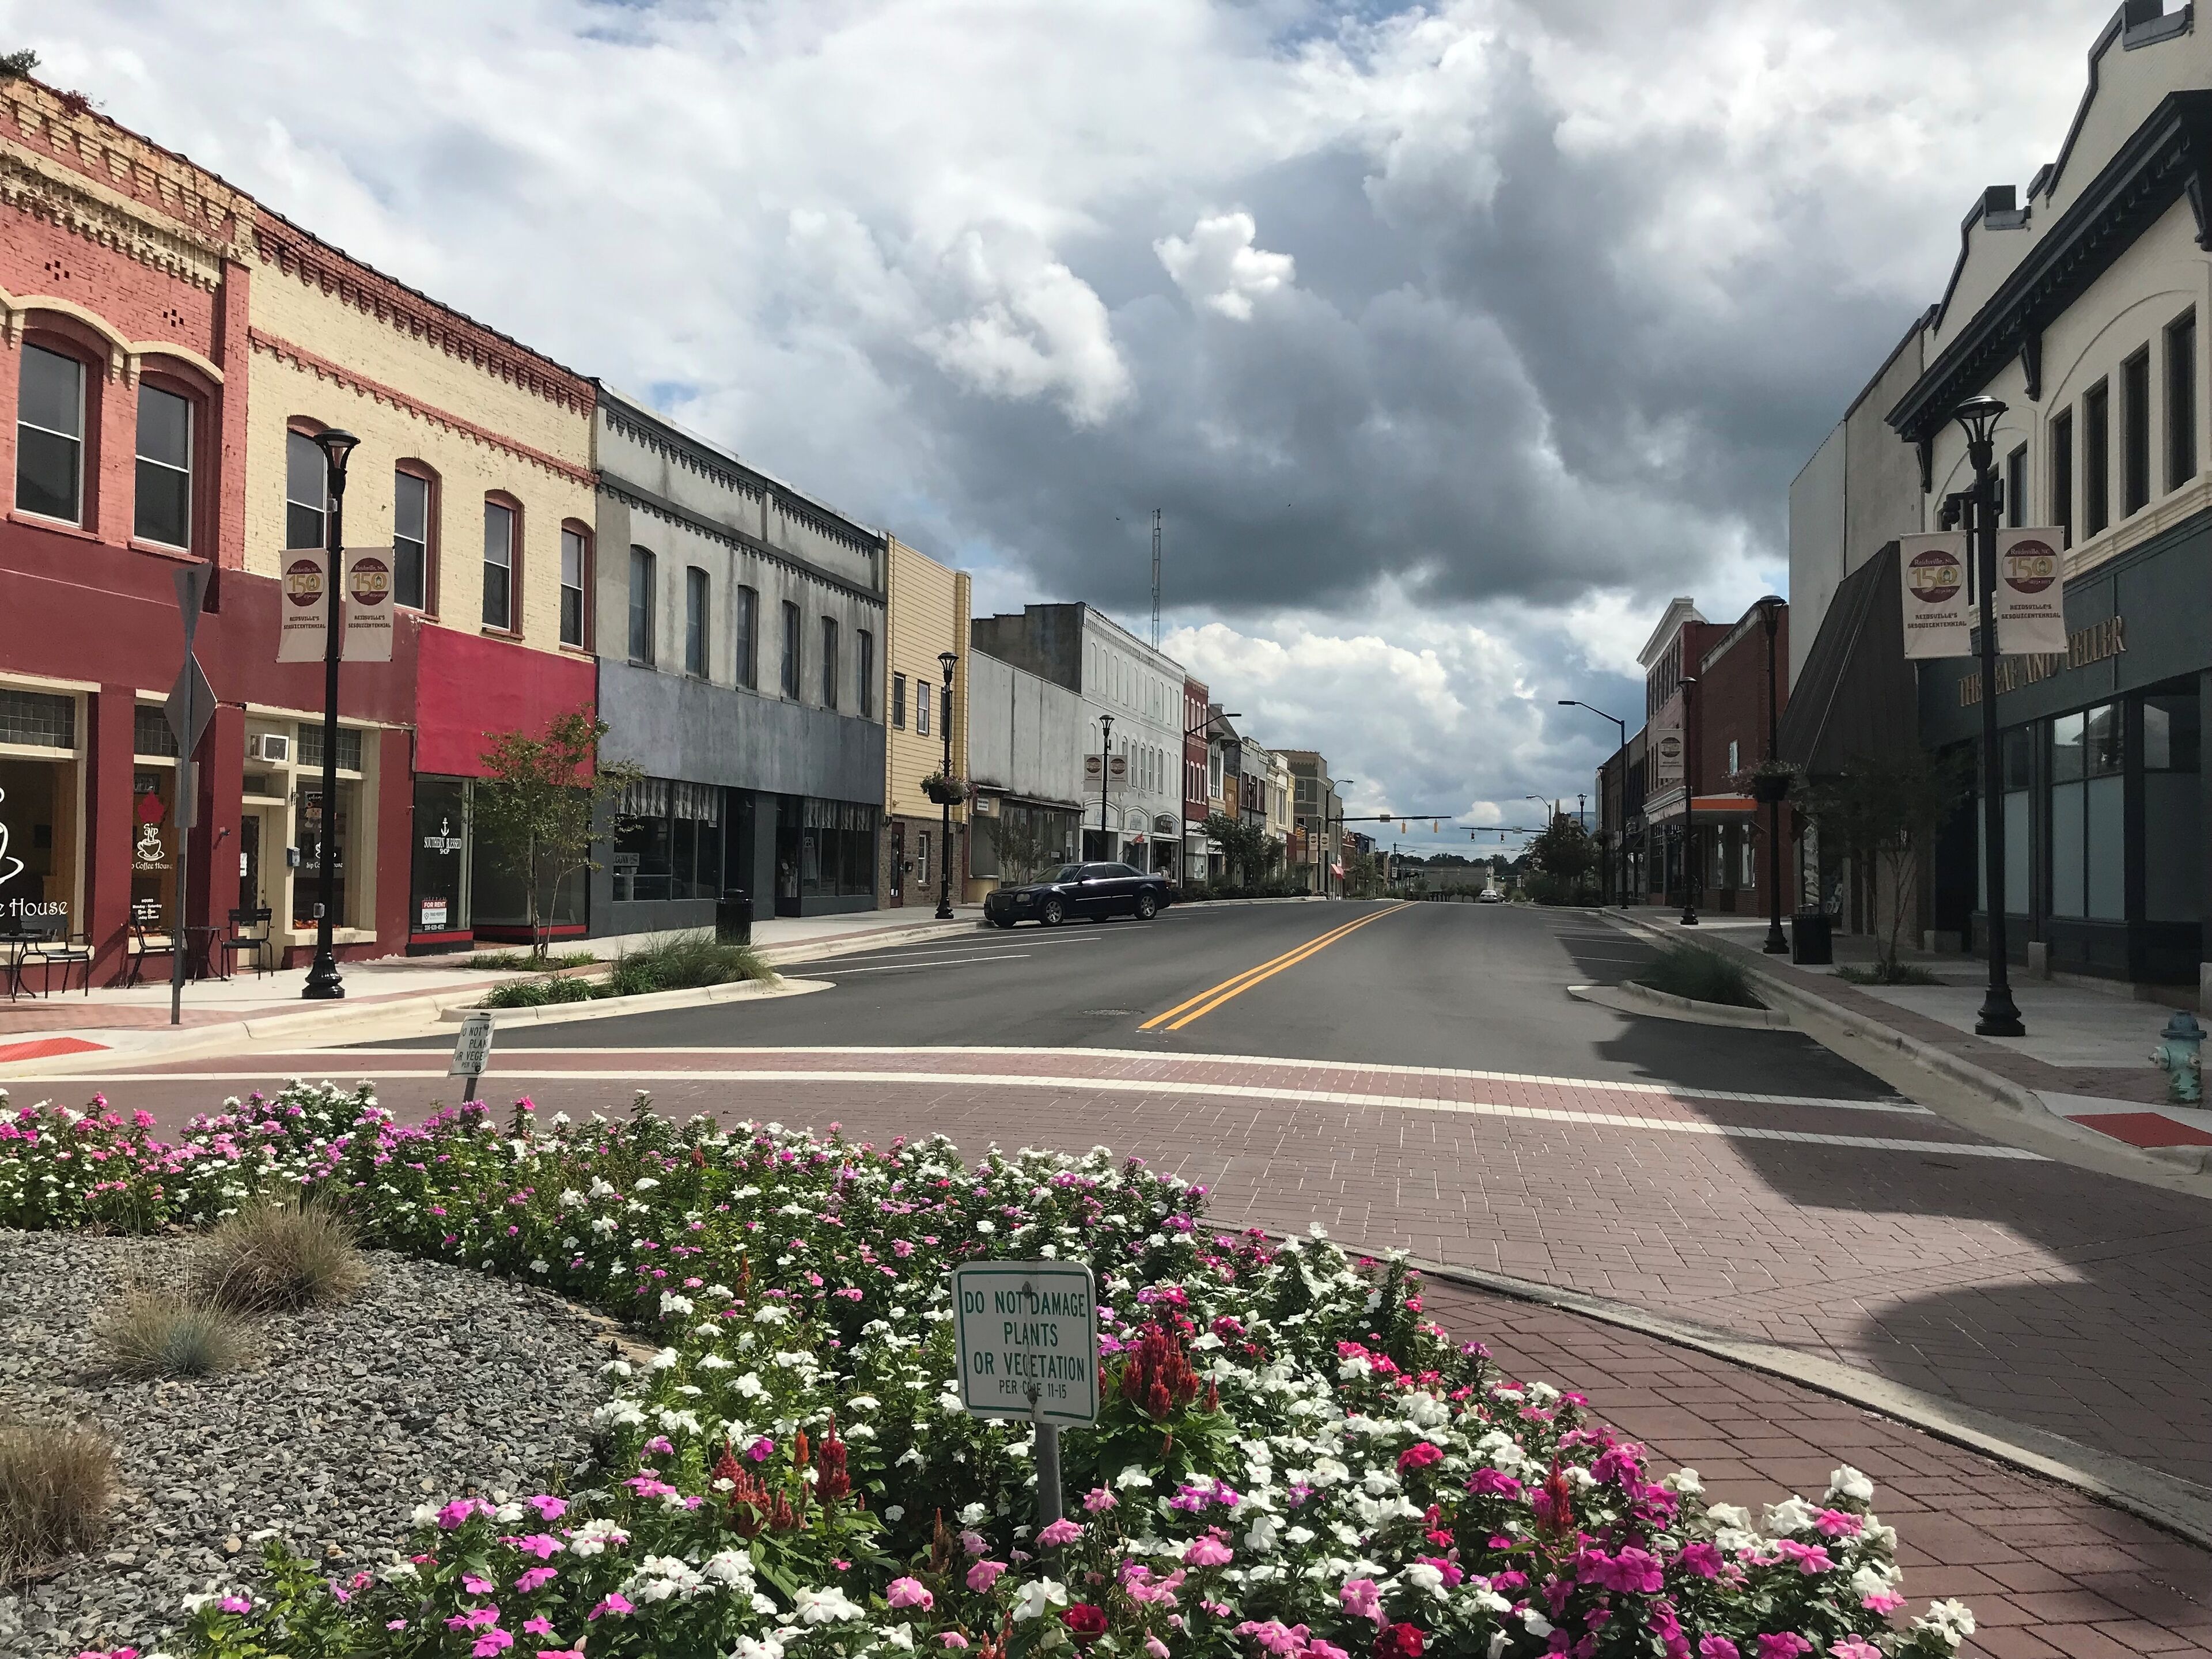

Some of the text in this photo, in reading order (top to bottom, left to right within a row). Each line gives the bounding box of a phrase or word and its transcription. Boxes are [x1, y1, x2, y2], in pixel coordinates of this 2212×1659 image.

[1912, 566, 1957, 593] 150
[2008, 557, 2052, 584] 150
[289, 574, 320, 598] 150
[353, 573, 387, 596] 150
[143, 823, 158, 842] Sip
[424, 836, 461, 849] SOUTHERN BLESSED
[136, 862, 154, 870] Coffee
[9, 897, 68, 917] House
[469, 1027, 483, 1036] NOT
[965, 1291, 1086, 1317] DO NOT DAMAGE
[1003, 1322, 1058, 1347] PLANTS
[974, 1351, 1085, 1382] OR VEGETATION
[999, 1380, 1017, 1394] PER
[1047, 1382, 1066, 1399] 11-15
